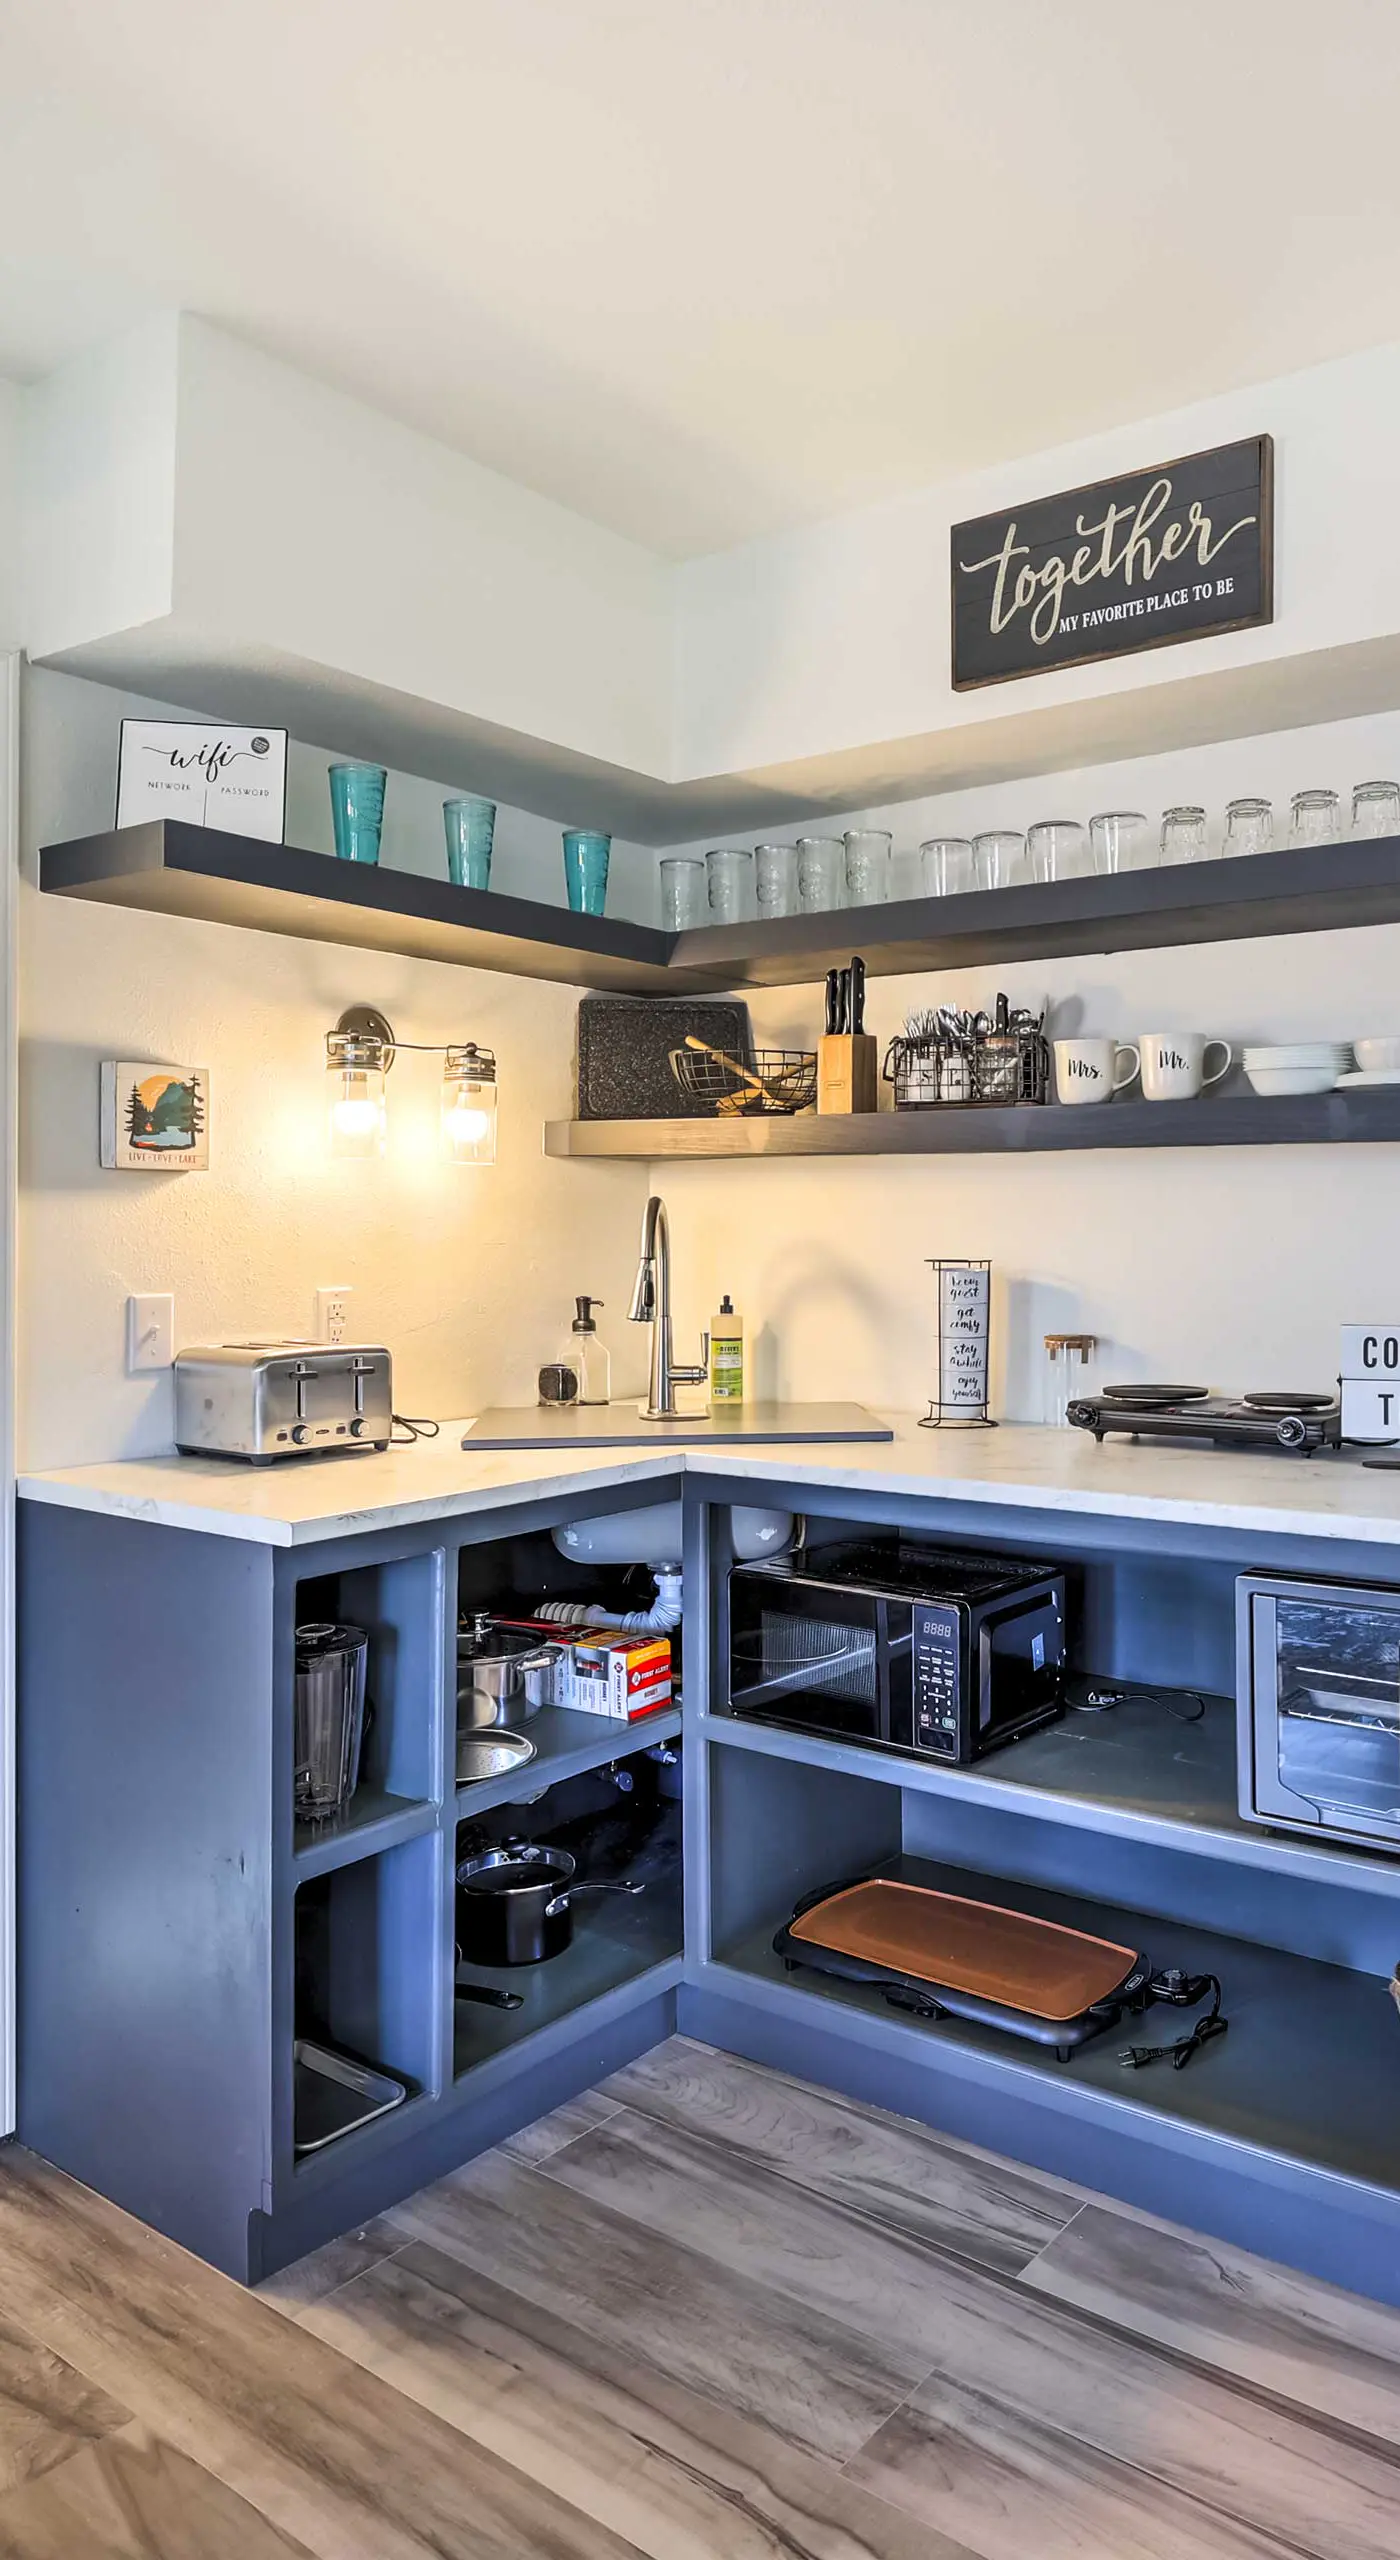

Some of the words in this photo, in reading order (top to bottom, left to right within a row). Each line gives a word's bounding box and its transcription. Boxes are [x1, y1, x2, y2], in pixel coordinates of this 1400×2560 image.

[960, 478, 1257, 645] together
[1059, 615, 1079, 634] MY
[1082, 600, 1145, 628] FAVORITE
[1146, 587, 1189, 613] PLACE
[1192, 583, 1213, 602] TO
[1216, 577, 1235, 596] BE
[142, 741, 268, 782] wifi
[147, 781, 191, 792] NETWORK
[220, 786, 270, 797] PASSWORD
[1068, 1058, 1103, 1079] Mrs.
[1159, 1050, 1190, 1070] Mr.
[954, 1344, 977, 1358] stay
[655, 1665, 669, 1674] ALERT
